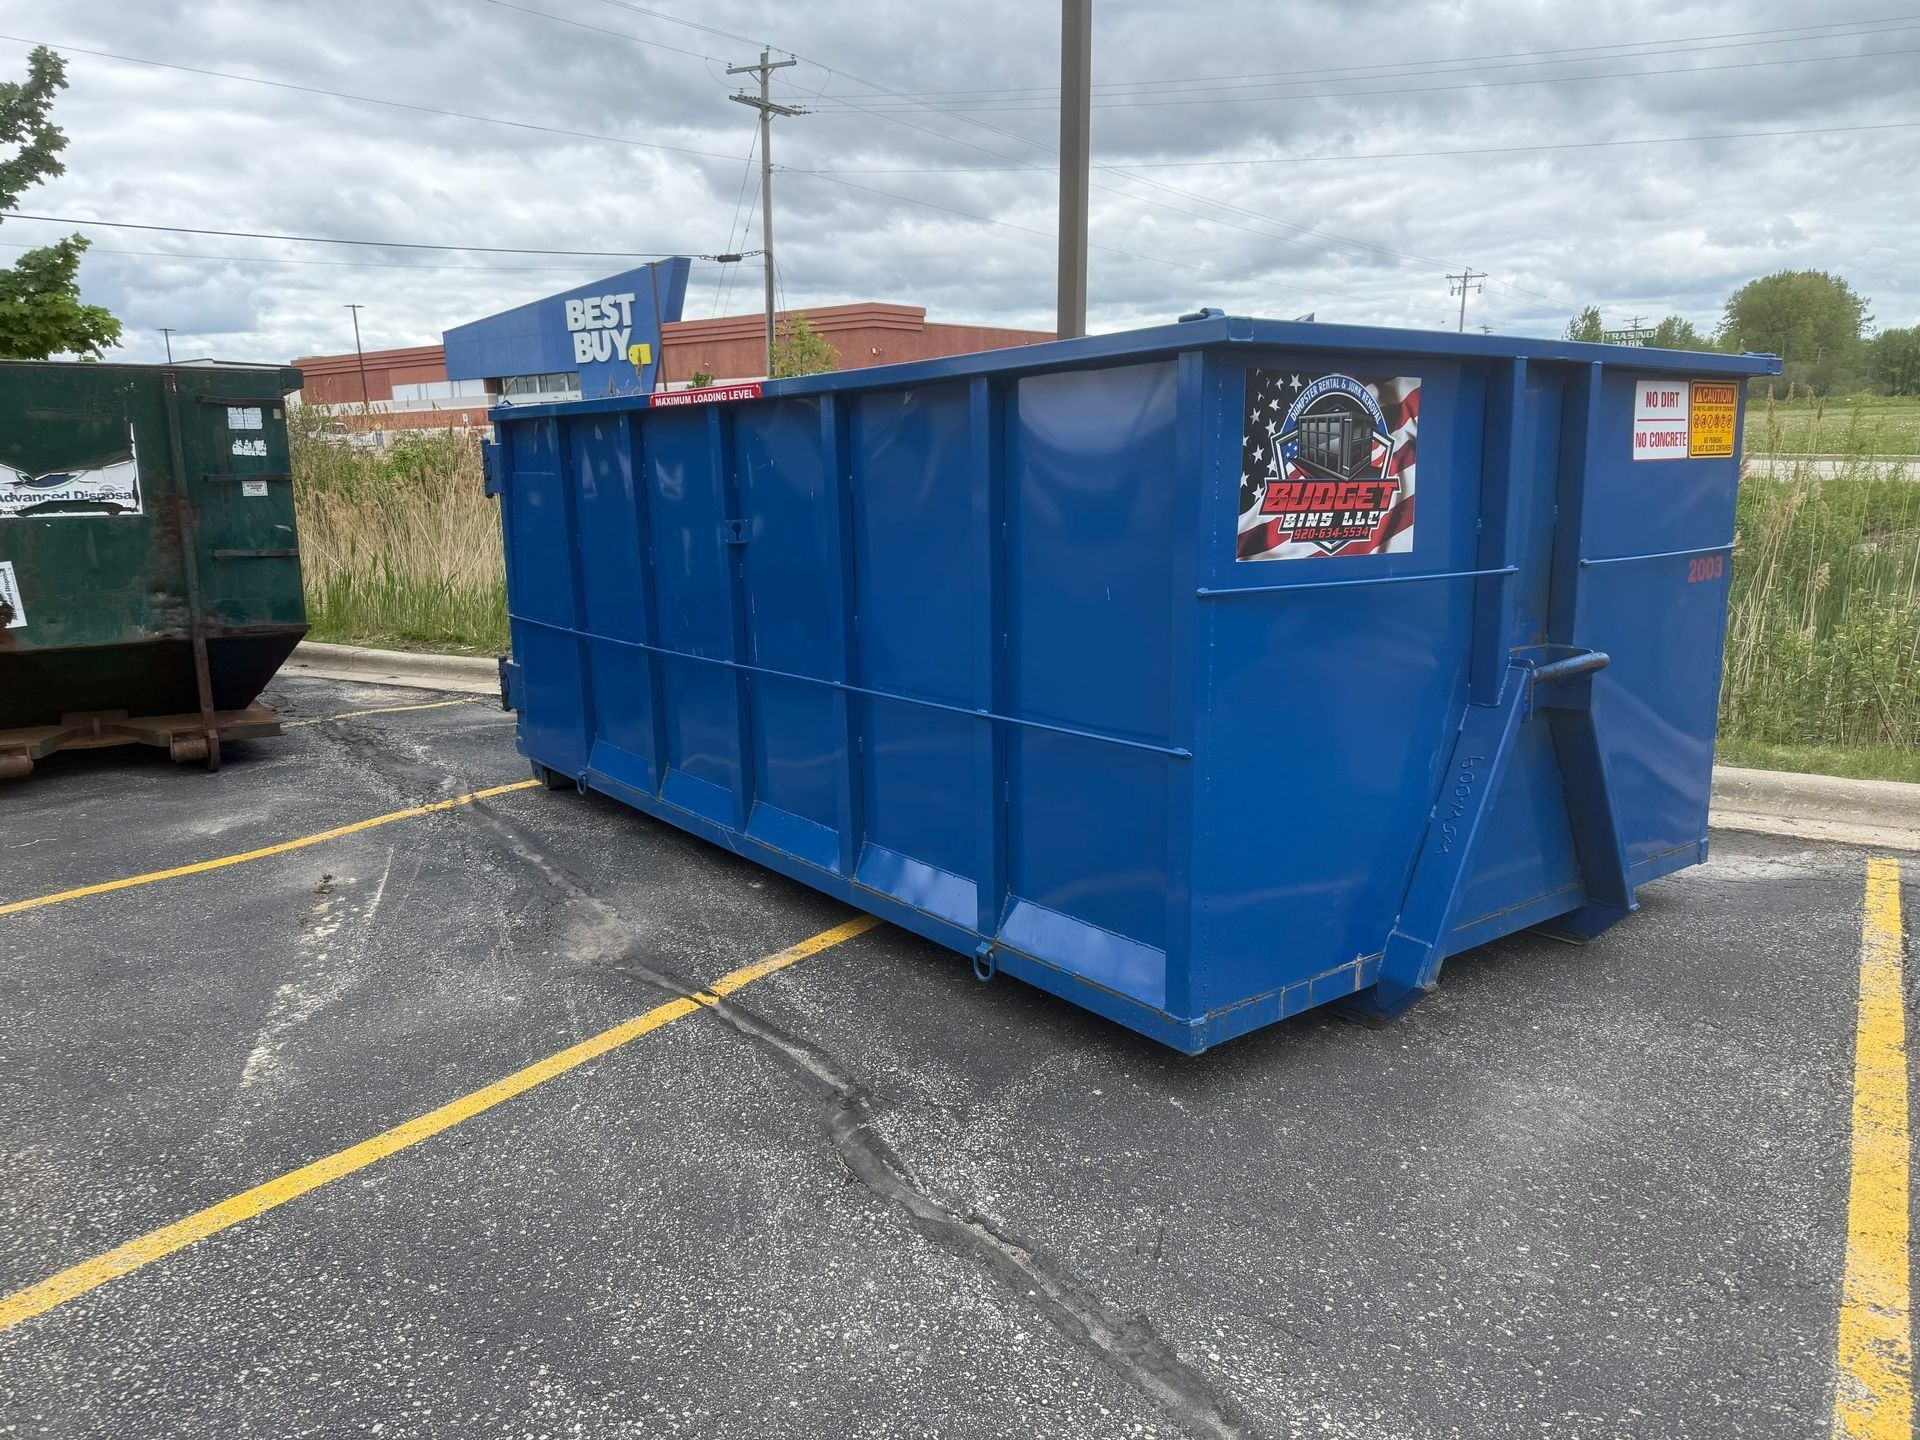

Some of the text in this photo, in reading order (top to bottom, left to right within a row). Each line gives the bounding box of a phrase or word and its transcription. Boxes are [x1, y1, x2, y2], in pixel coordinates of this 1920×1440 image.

[565, 292, 636, 332] BEST
[573, 327, 632, 364] BUY
[655, 389, 755, 407] MAXIMUM LOADING LEVEL
[1290, 378, 1384, 425] DUMPSTER RENTAL & JUNK REMOVAL
[1645, 391, 1680, 408] NO DIRT
[1703, 388, 1733, 403] CAUTION
[1635, 431, 1687, 448] NO CONCRETE
[73, 490, 133, 502] Disposa
[1262, 482, 1399, 511] BUDGET
[1283, 510, 1380, 528] BINS LLC
[1293, 526, 1370, 540] 920-634-5534
[1687, 555, 1724, 583] 2003
